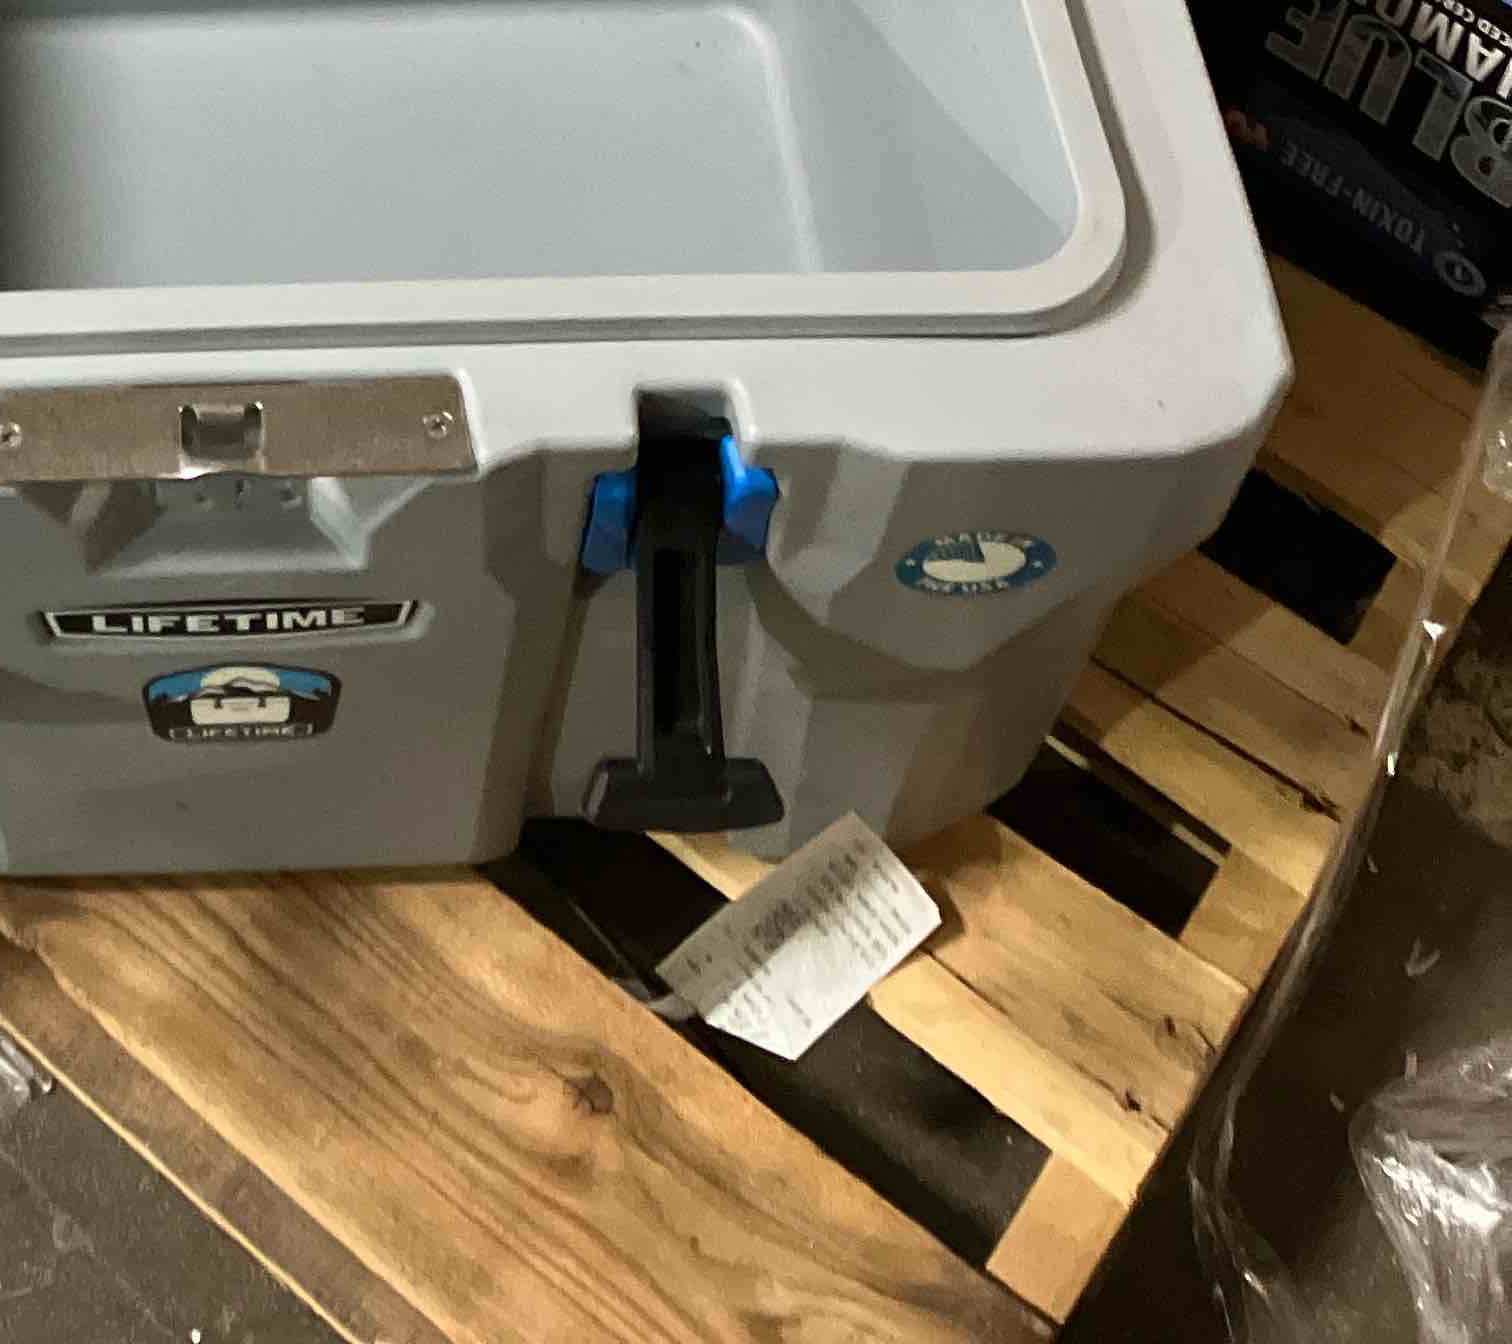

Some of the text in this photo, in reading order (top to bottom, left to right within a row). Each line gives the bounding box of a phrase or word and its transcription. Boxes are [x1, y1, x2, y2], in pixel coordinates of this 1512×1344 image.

[1477, 17, 1512, 49] CED
[91, 607, 365, 633] LIFETIME
[186, 725, 296, 739] LIFETIME
